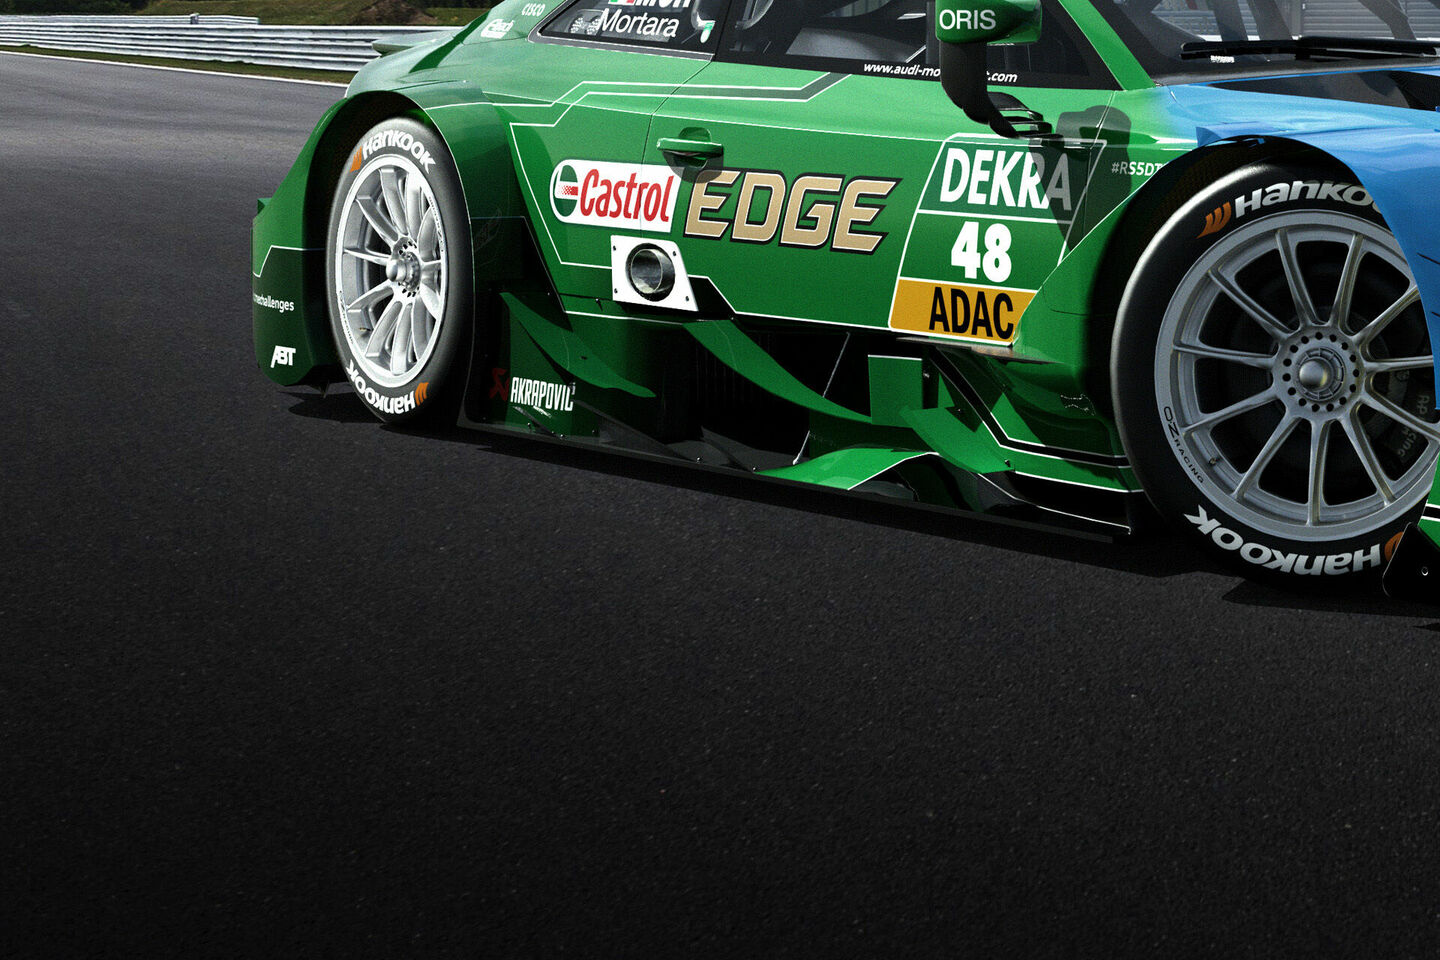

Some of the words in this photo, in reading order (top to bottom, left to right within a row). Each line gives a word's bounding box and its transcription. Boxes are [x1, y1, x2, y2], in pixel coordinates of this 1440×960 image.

[598, 7, 680, 38] Mortara
[938, 8, 997, 31] ORIS
[940, 147, 1073, 211] DEKRA
[580, 168, 675, 223] Castrol
[683, 167, 903, 256] EDGE
[951, 220, 1012, 283] 48
[928, 286, 1014, 340] ADAC
[270, 345, 297, 369] ABT
